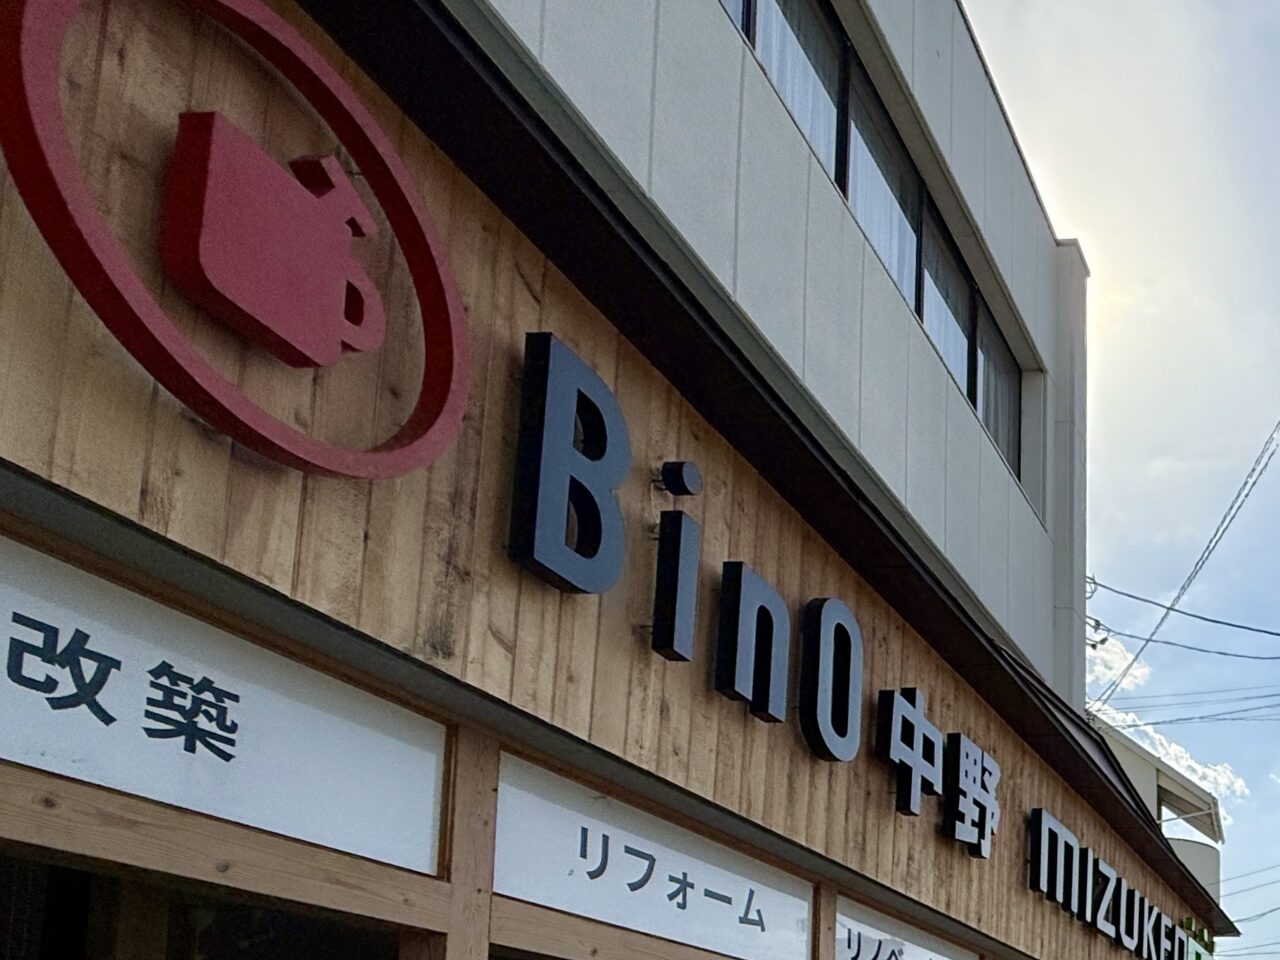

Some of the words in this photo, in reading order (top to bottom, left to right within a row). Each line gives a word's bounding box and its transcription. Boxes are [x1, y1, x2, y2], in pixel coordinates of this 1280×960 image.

[6, 611, 240, 762] 改築
[579, 826, 766, 933] リフォーム
